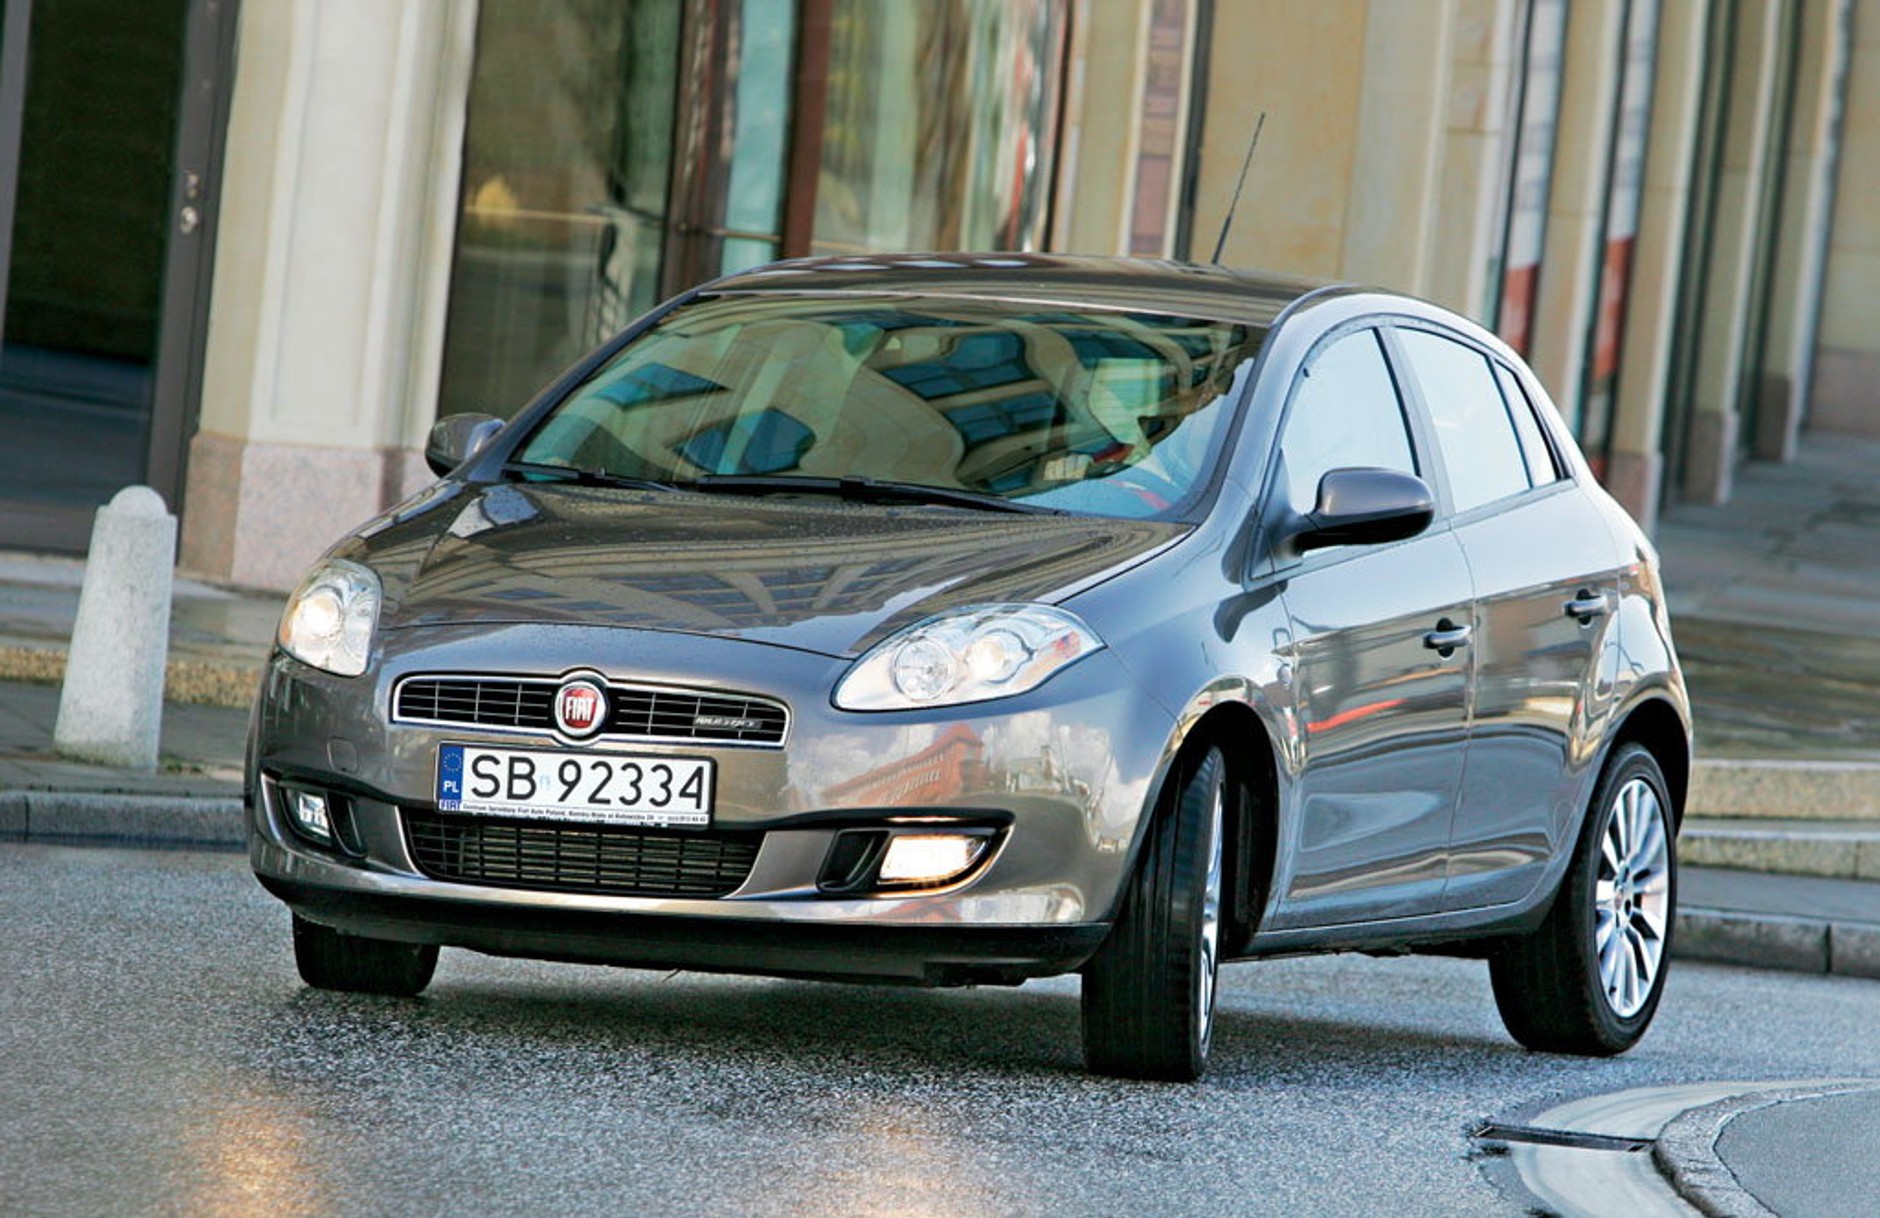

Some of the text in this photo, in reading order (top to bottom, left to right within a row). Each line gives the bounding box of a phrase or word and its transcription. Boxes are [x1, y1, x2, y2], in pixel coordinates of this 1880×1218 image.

[565, 696, 596, 722] FIAT
[443, 781, 459, 793] PL
[471, 755, 704, 809] SB 92334
